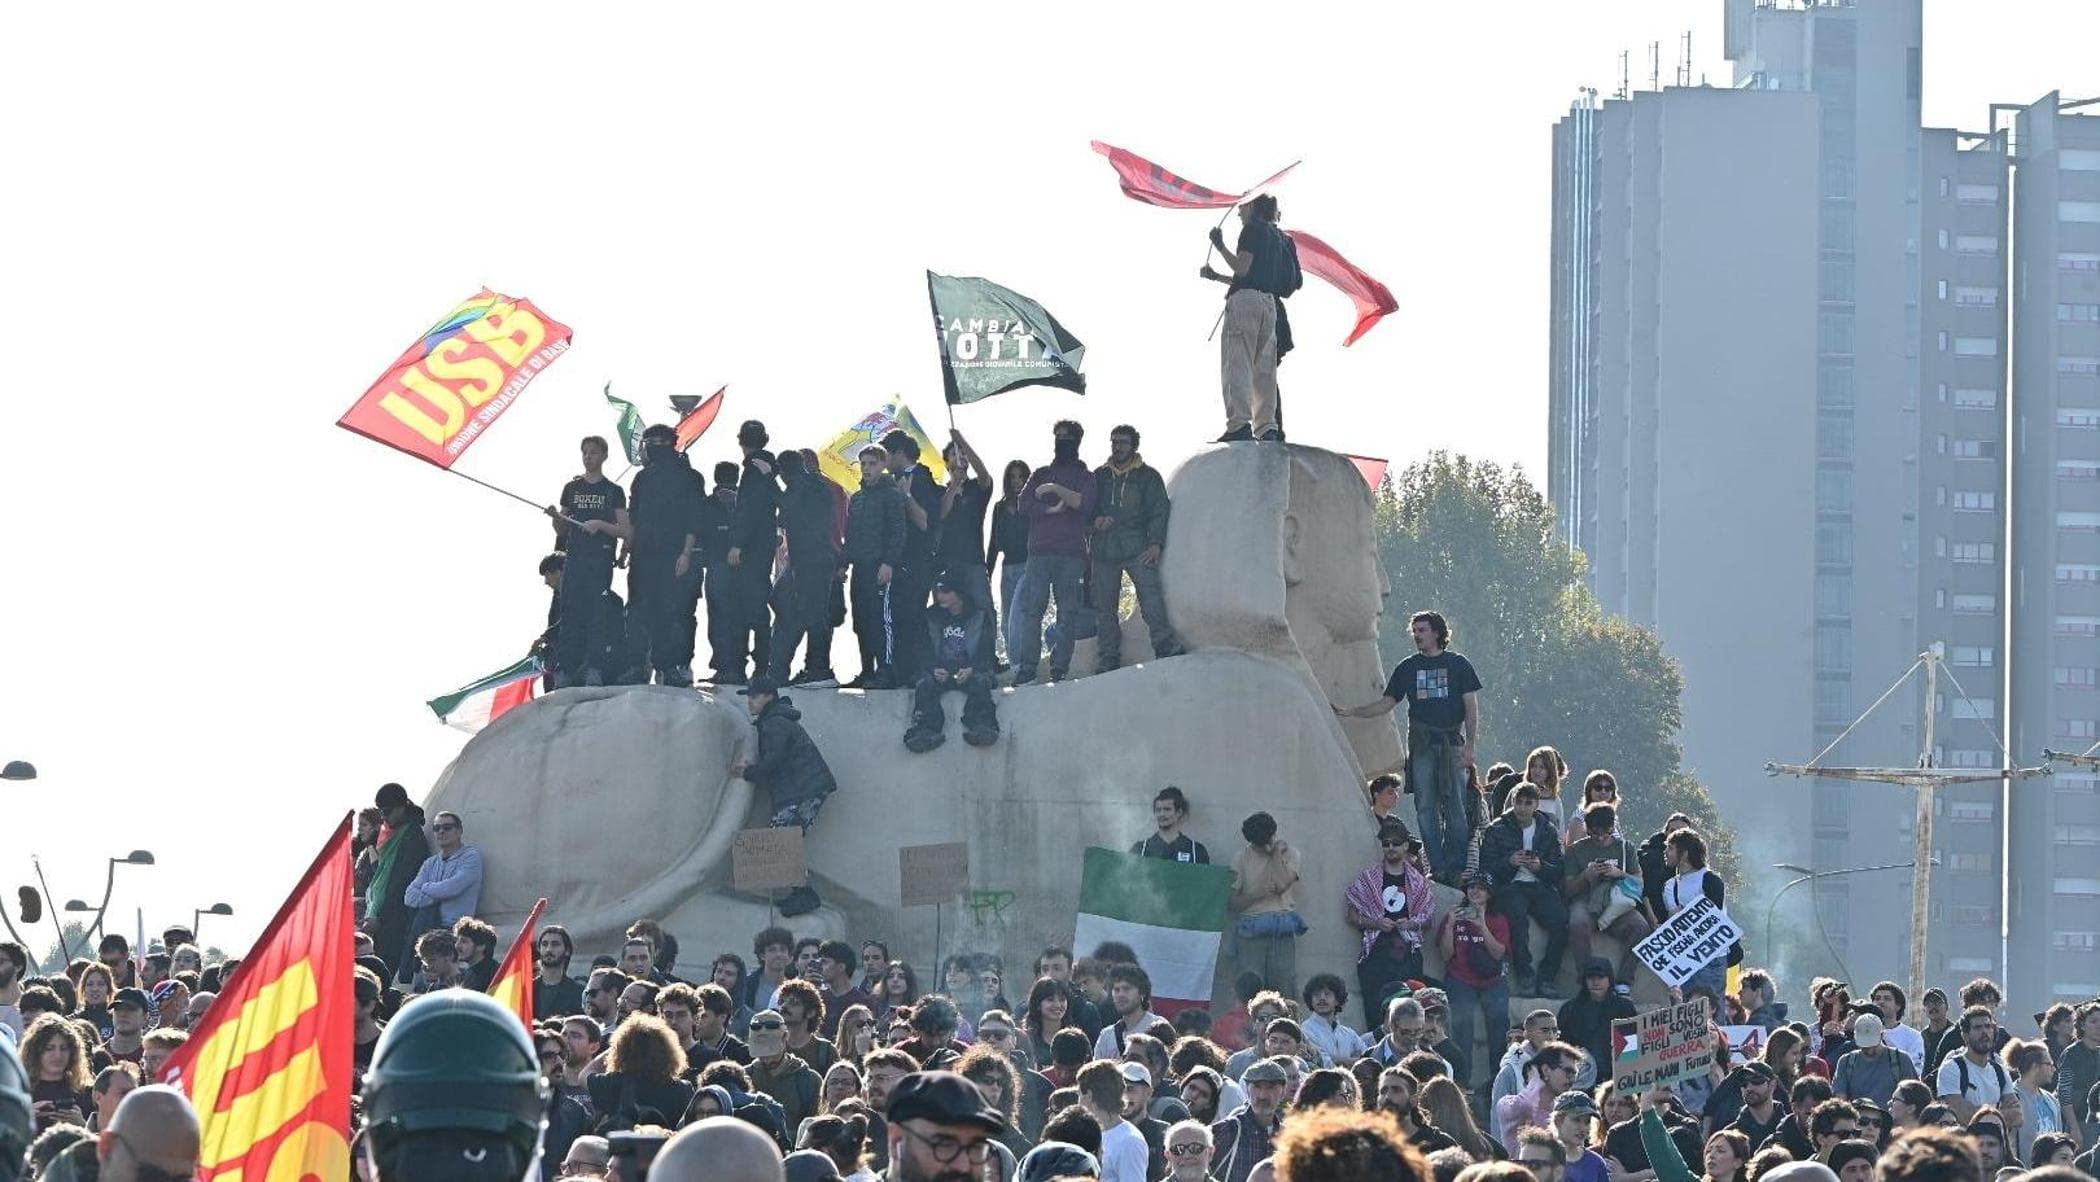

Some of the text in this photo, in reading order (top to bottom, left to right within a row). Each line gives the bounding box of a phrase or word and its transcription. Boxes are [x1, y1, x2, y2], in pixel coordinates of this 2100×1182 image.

[943, 331, 1055, 360] OTT
[378, 302, 546, 445] USB
[528, 354, 544, 369] DI
[1637, 927, 1677, 962] FASCIO
[1668, 925, 1734, 980] IL VENTO
[1651, 1009, 1672, 1027] MIEI
[1677, 1000, 1704, 1019] FIGLI
[1643, 1015, 1704, 1042] NON SONO
[1641, 1035, 1670, 1055] FIGLI
[1659, 1039, 1706, 1060] GUERRA
[1638, 1070, 1652, 1085] LE
